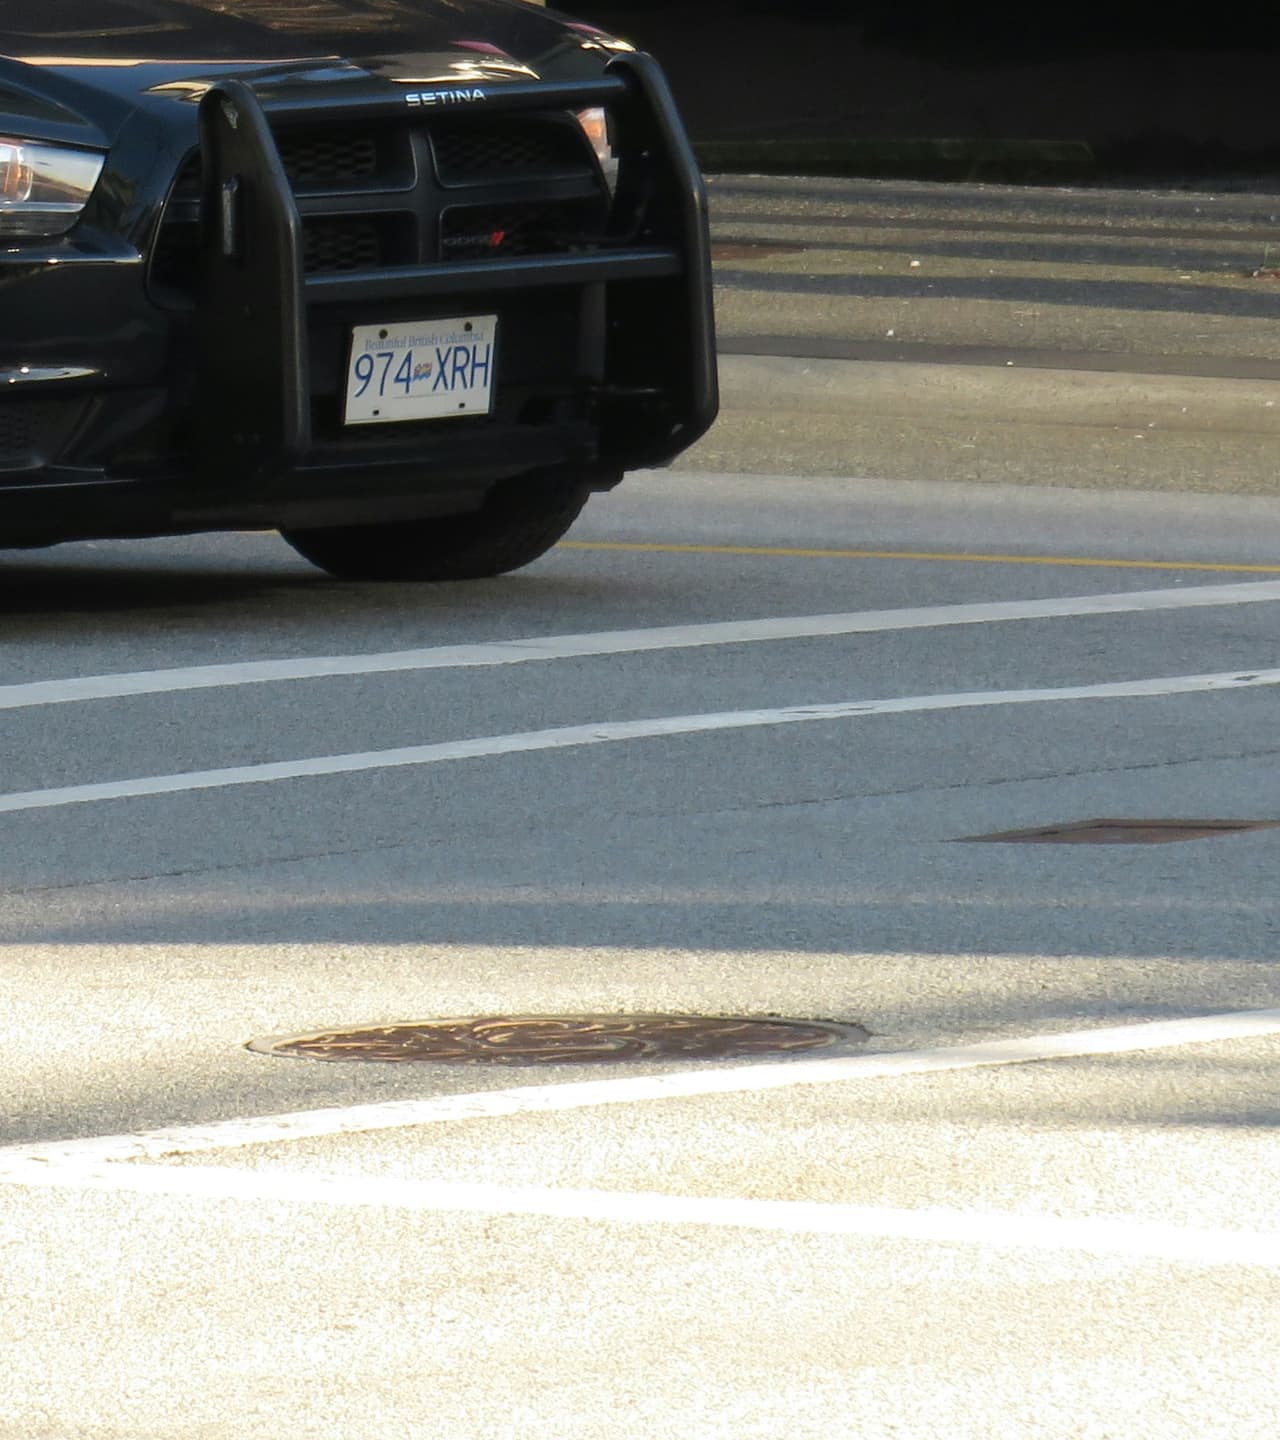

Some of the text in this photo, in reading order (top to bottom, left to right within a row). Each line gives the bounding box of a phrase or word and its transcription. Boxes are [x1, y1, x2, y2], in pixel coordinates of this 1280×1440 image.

[405, 88, 487, 107] SETINA
[354, 344, 491, 398] 974 XRH
